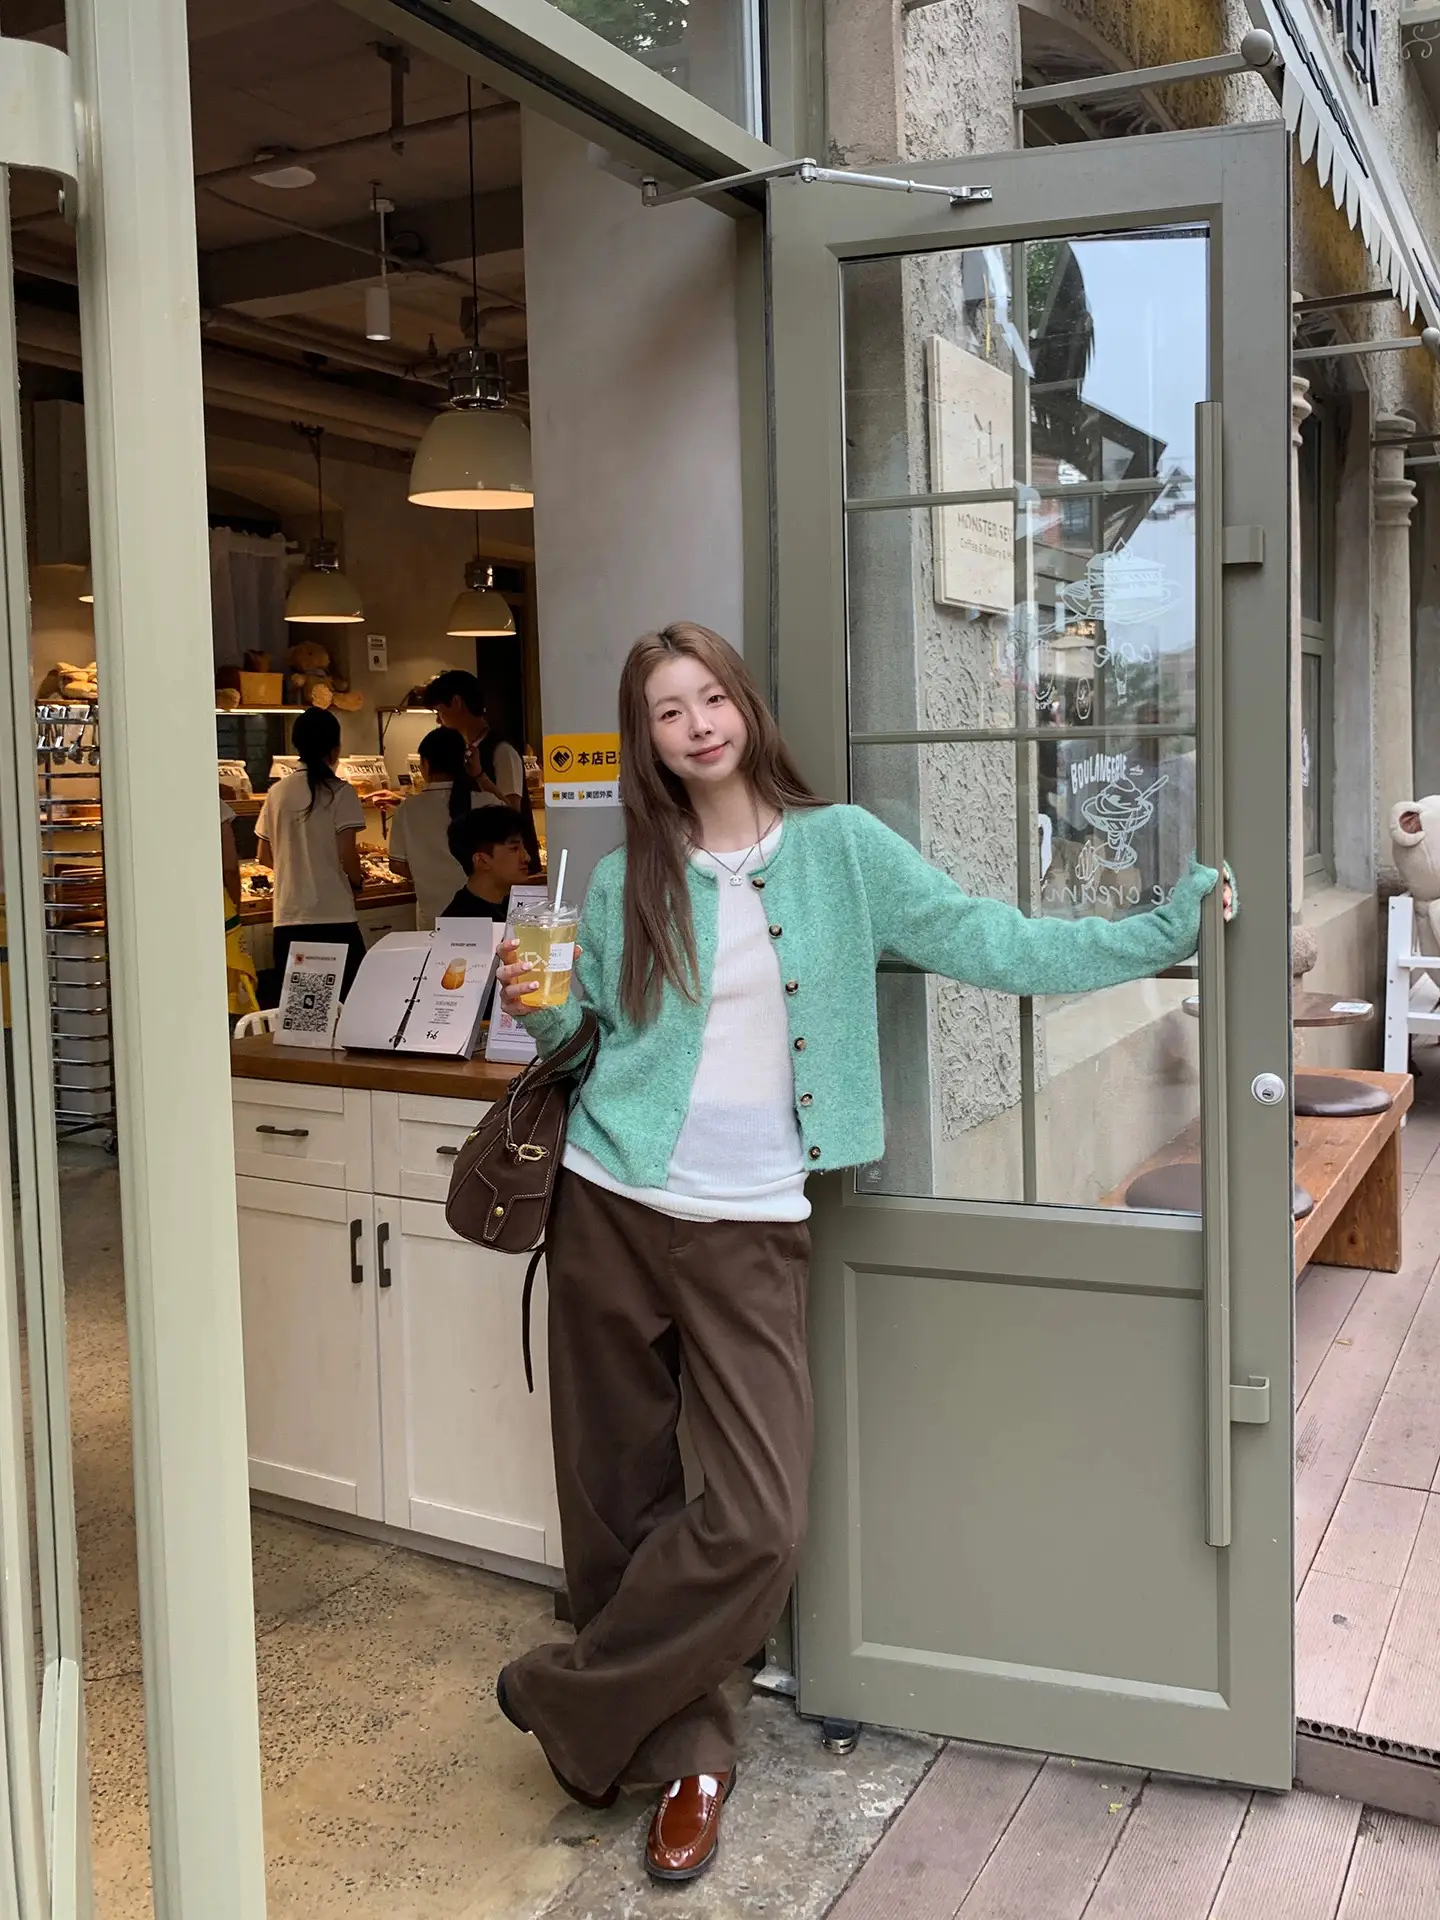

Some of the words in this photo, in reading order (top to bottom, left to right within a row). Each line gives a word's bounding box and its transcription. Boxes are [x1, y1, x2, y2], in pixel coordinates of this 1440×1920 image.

[957, 512, 997, 539] MONSTER
[577, 751, 621, 766] 本店已
[347, 764, 374, 774] BAKERY
[561, 791, 575, 800] 美团
[586, 790, 613, 799] 美团外卖
